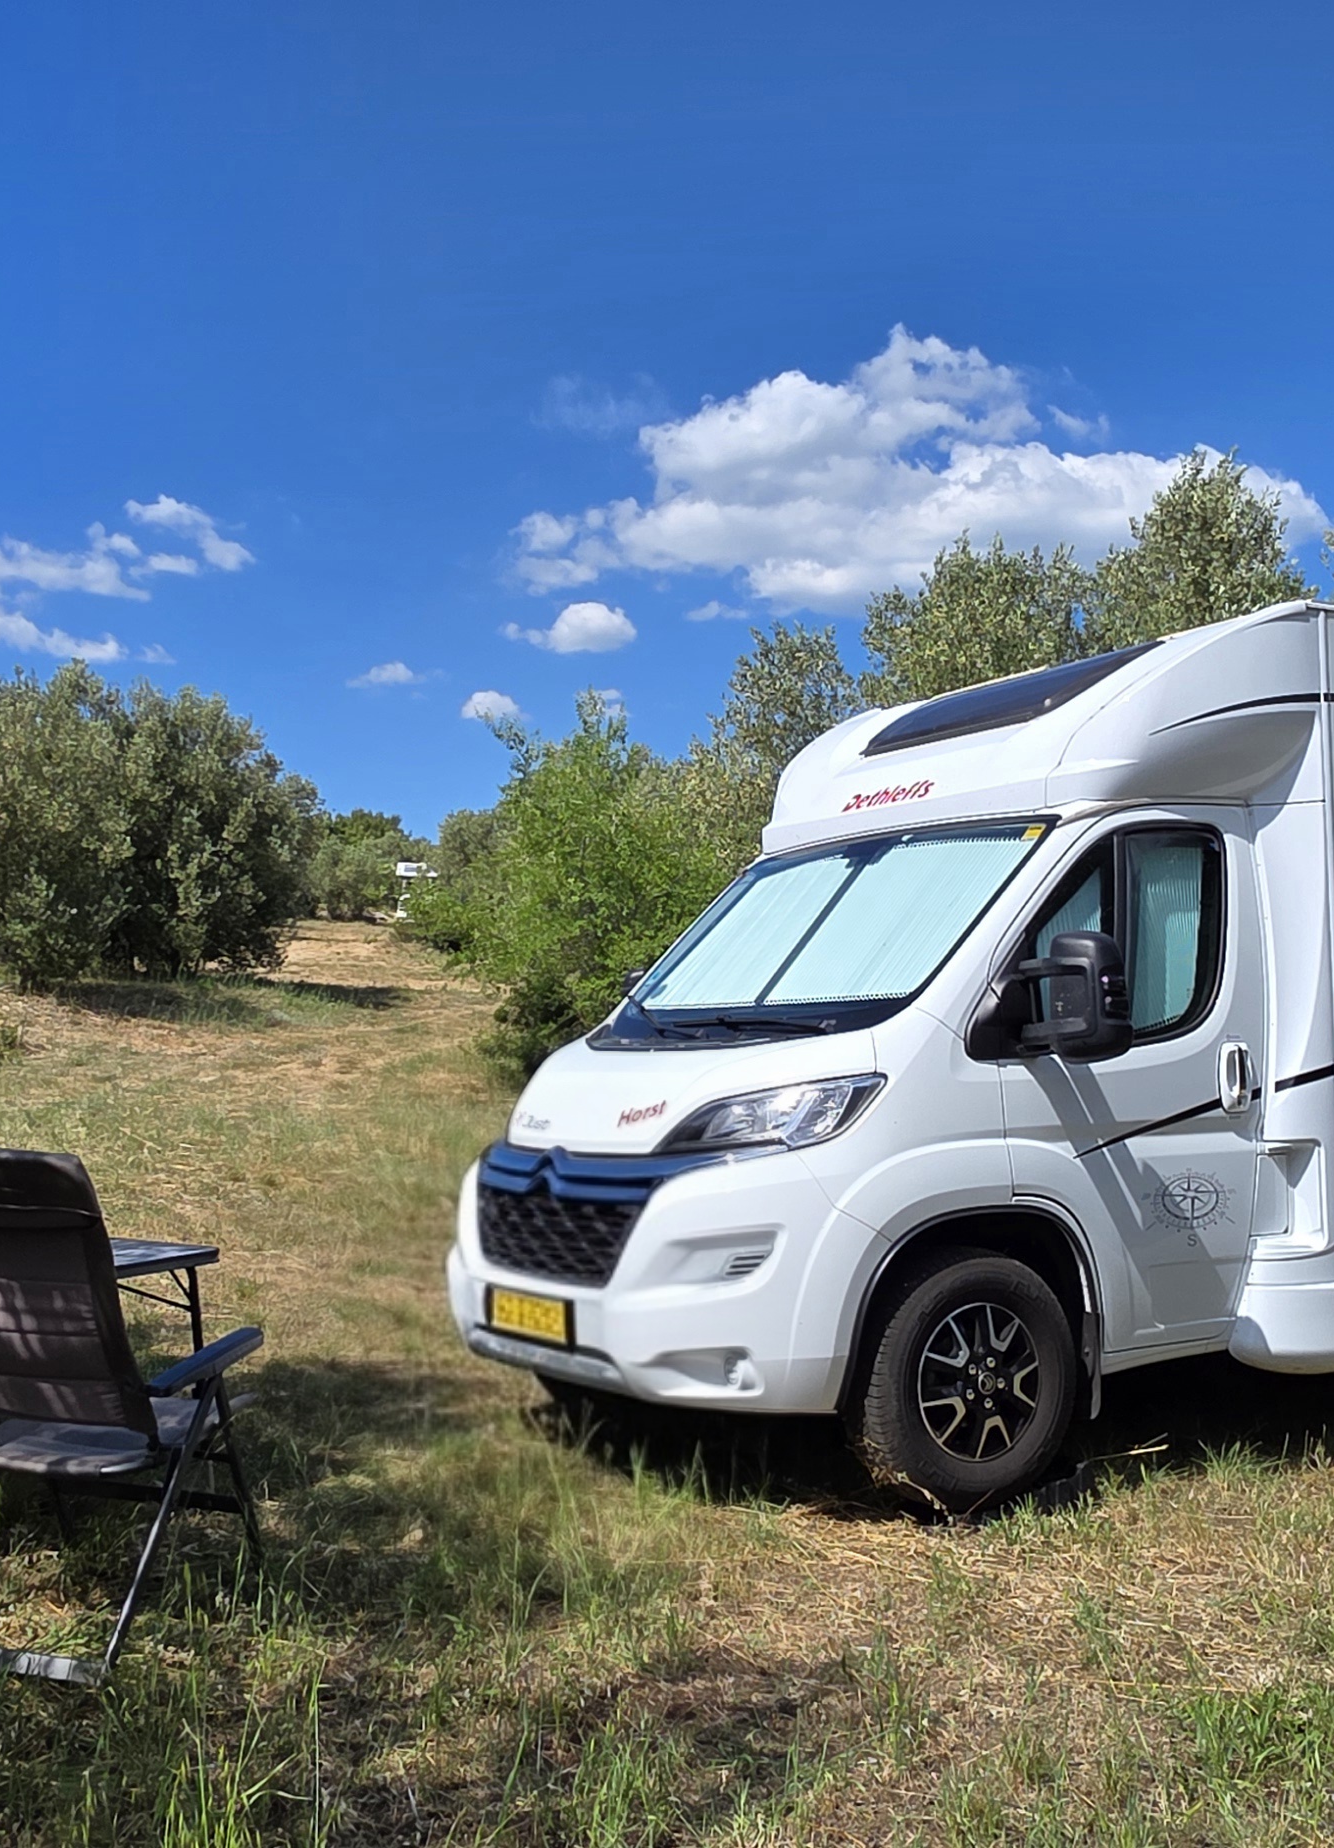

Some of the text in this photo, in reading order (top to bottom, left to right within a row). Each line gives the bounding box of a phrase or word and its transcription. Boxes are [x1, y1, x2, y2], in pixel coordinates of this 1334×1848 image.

[841, 779, 935, 813] Dethleffs
[616, 1100, 666, 1127] Horst
[1187, 1233, 1198, 1247] S
